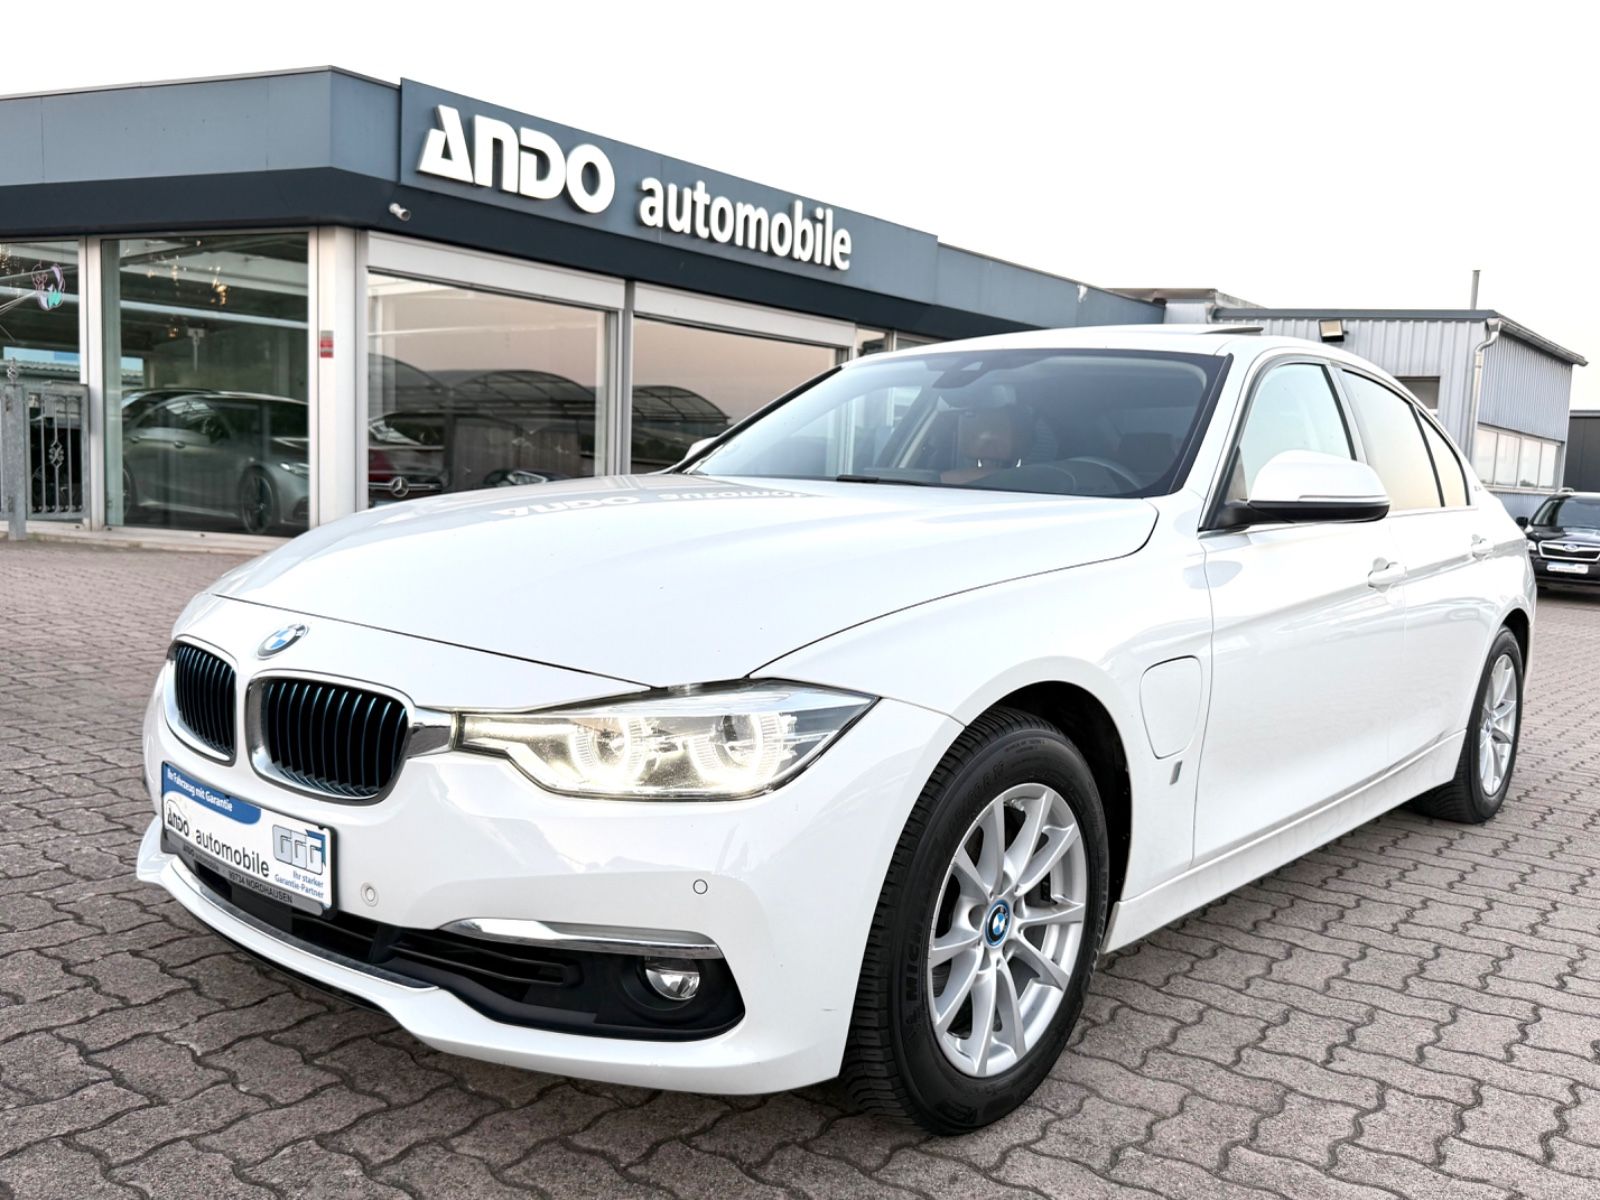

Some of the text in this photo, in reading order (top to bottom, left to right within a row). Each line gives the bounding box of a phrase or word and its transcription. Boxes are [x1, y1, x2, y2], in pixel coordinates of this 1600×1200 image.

[418, 103, 852, 271] ANDO automobile
[195, 787, 206, 800] mit
[205, 790, 233, 812] Garantie
[196, 829, 270, 878] automobile
